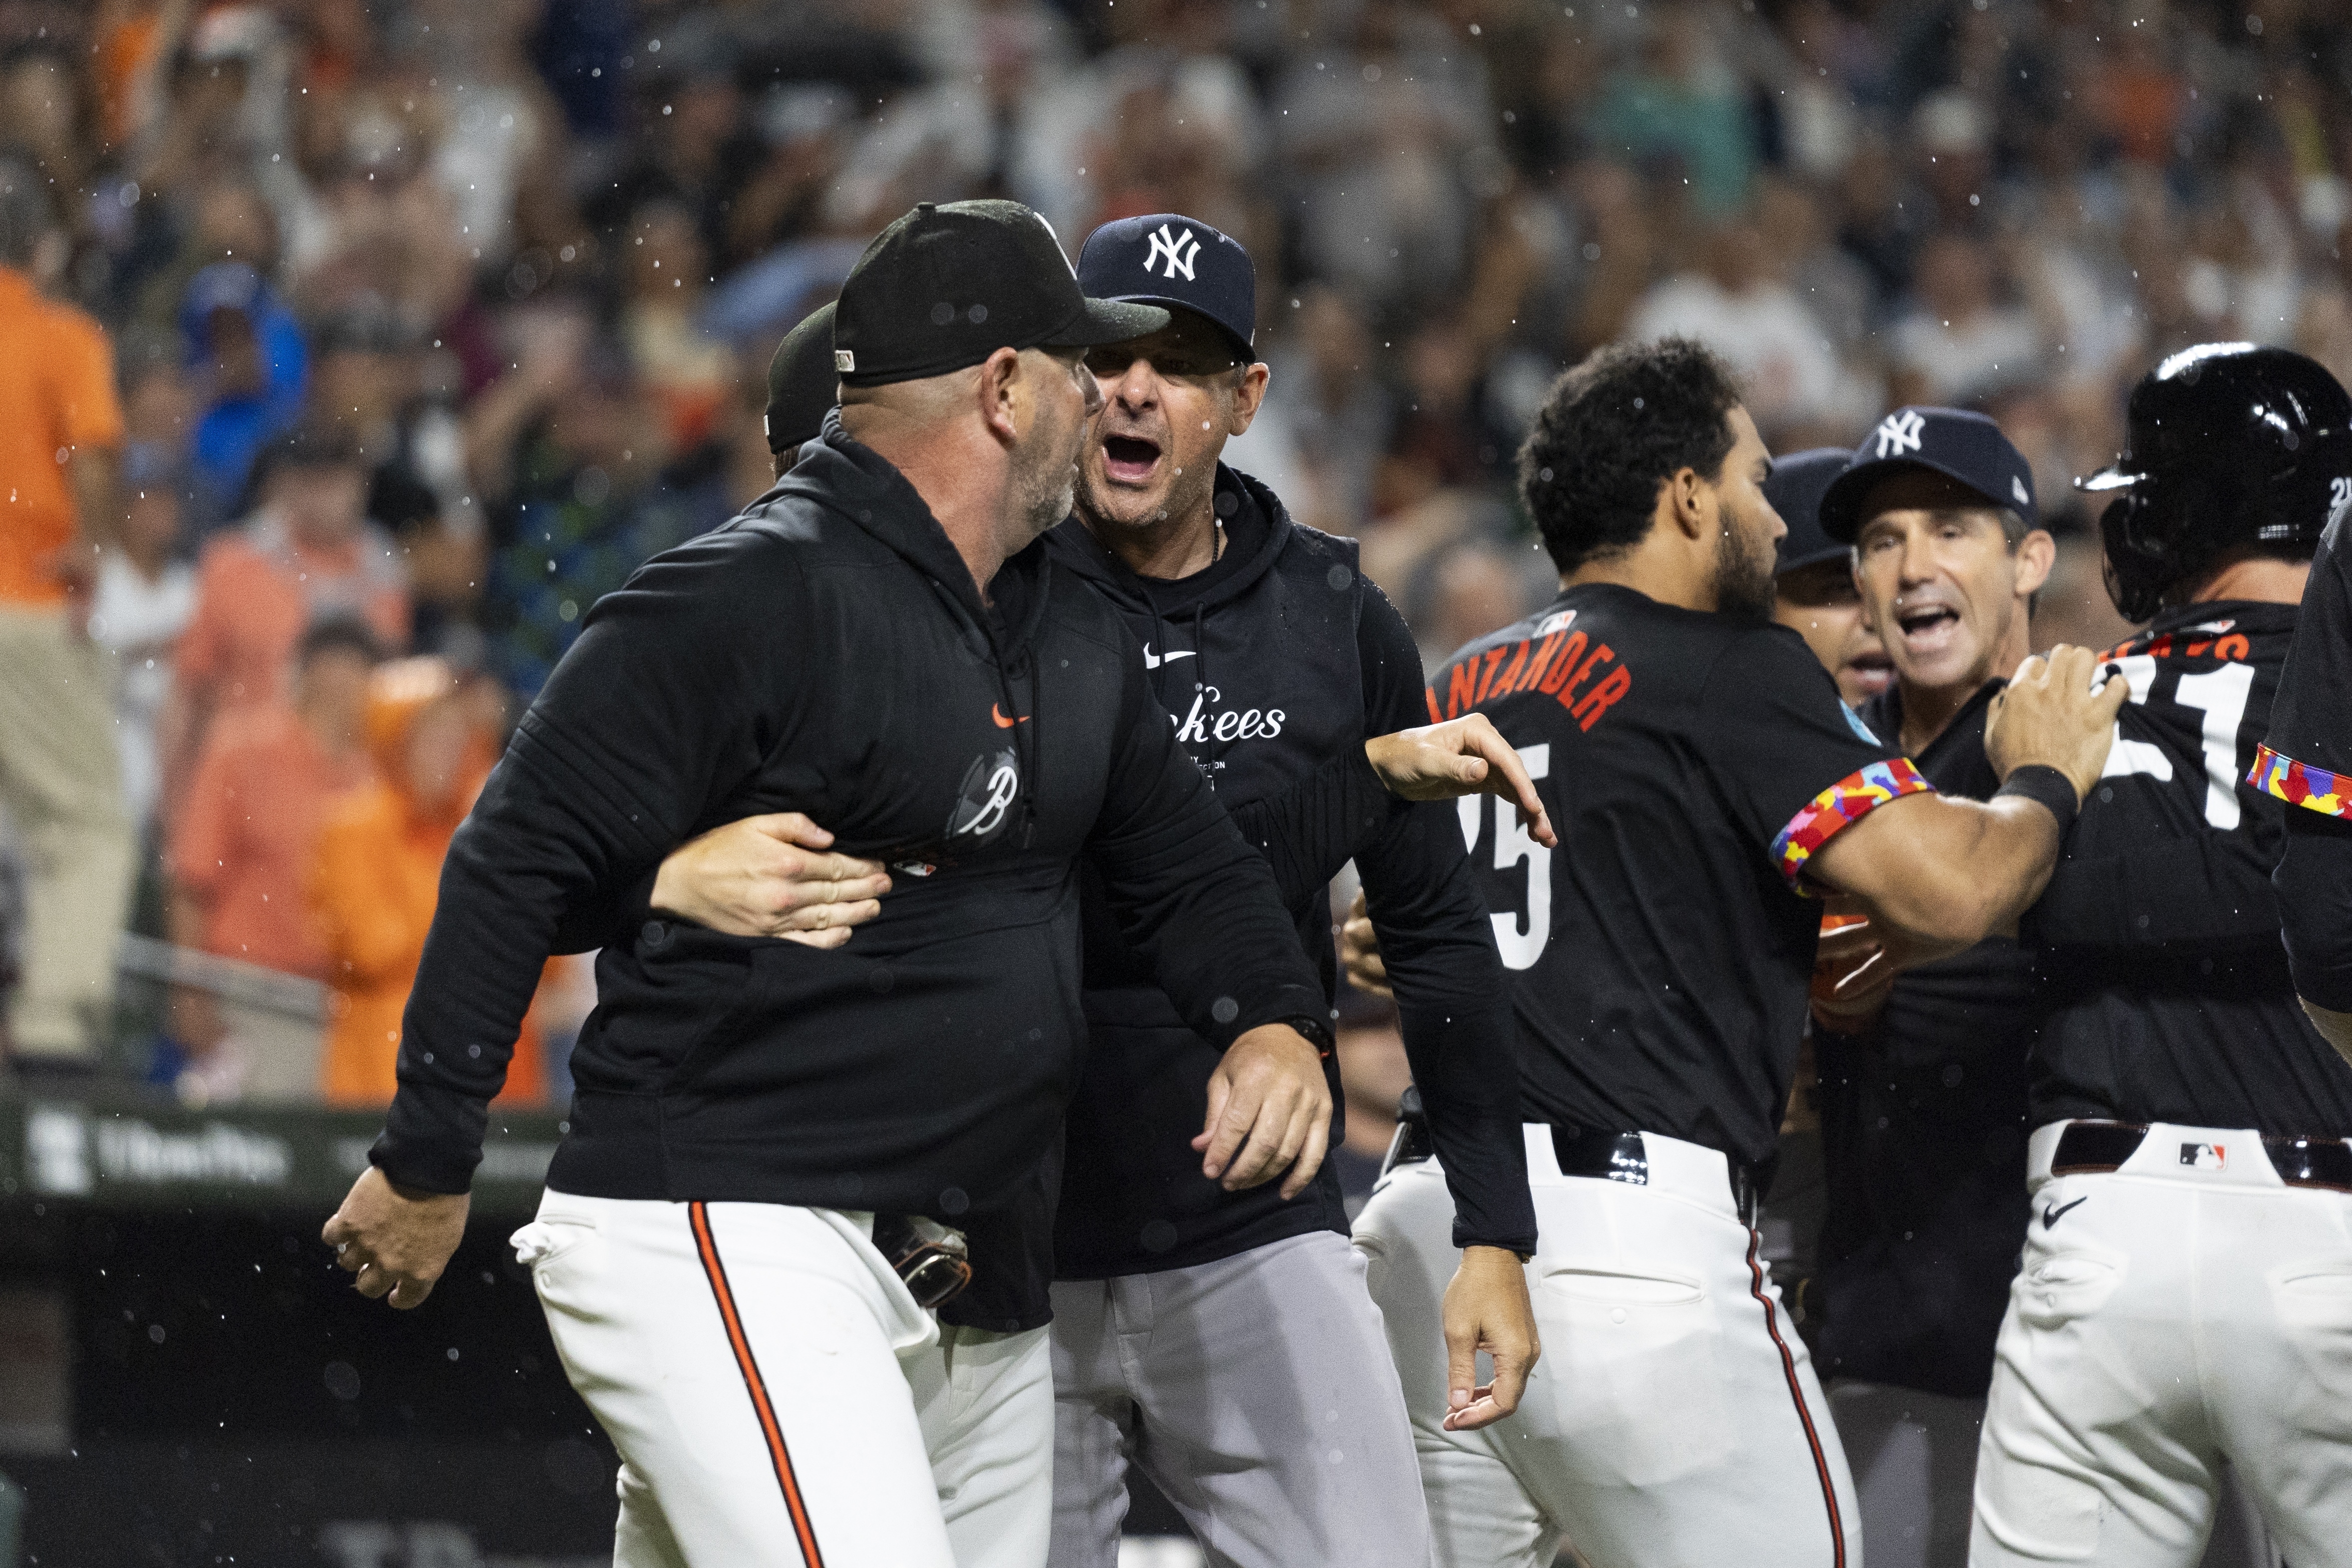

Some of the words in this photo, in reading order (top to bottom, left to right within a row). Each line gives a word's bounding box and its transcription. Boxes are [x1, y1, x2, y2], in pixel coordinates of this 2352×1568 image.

[1143, 224, 1201, 281] NY
[1876, 410, 1926, 459] NY
[1458, 744, 1552, 971] 5
